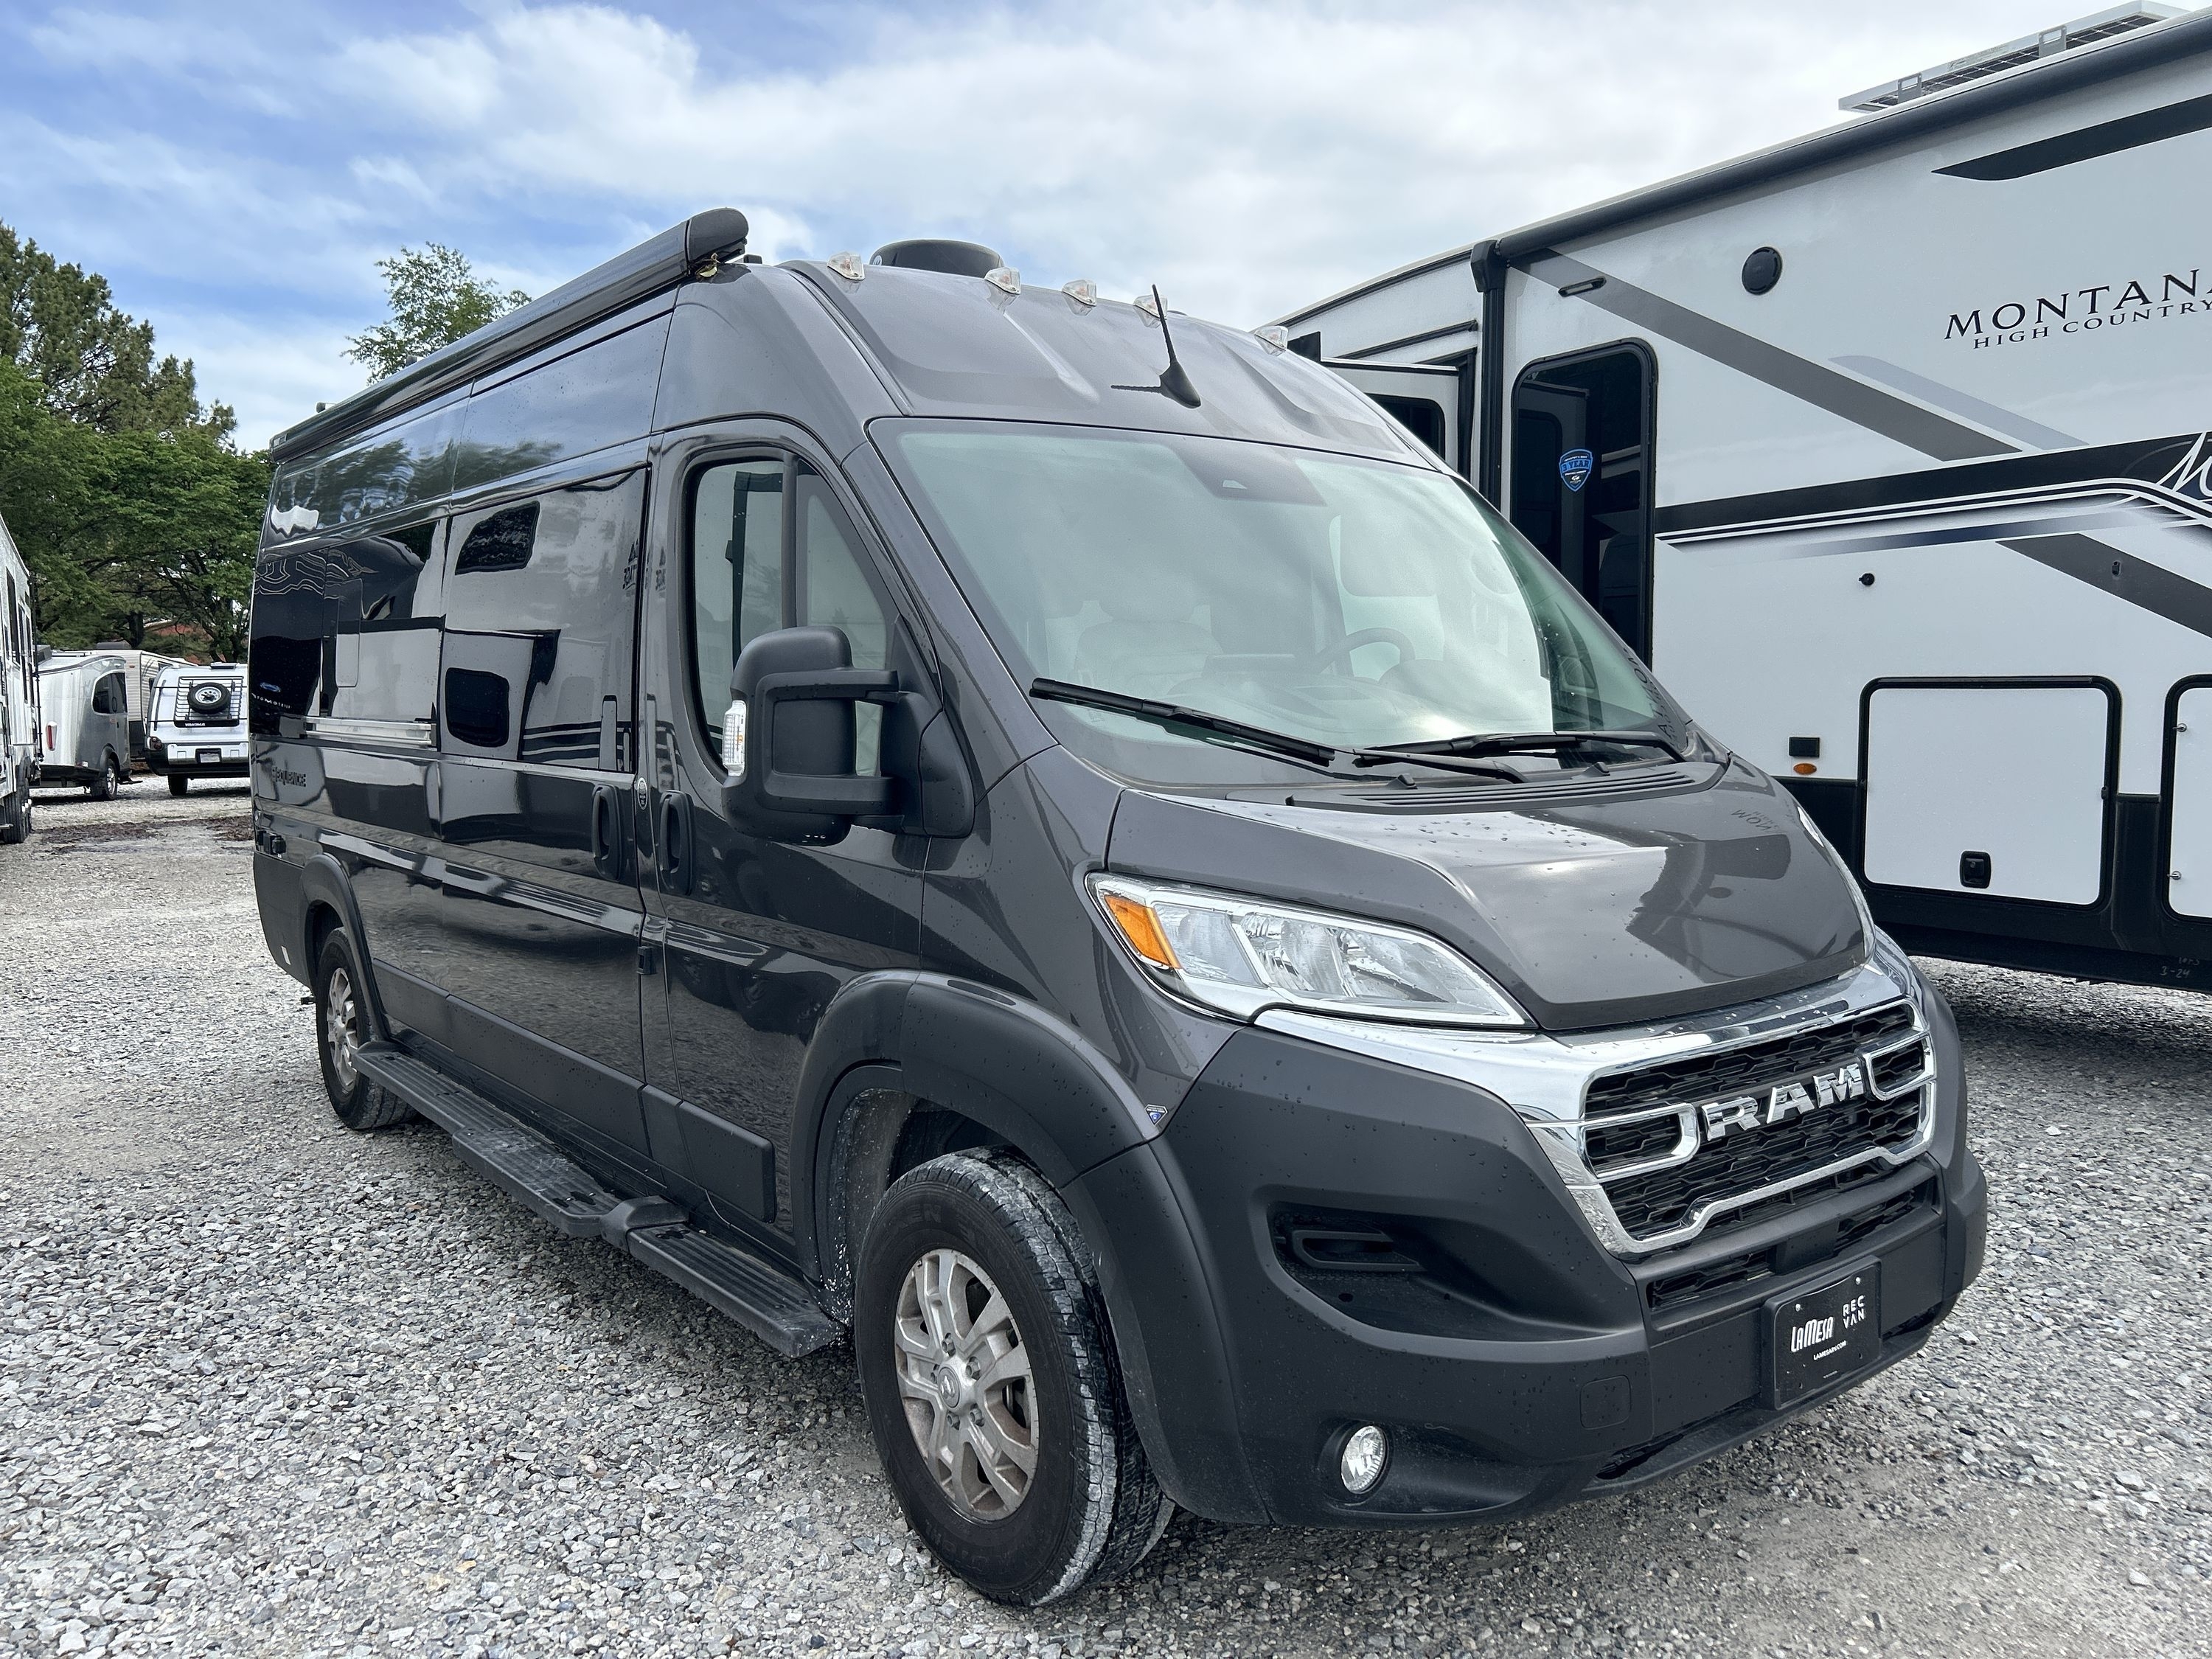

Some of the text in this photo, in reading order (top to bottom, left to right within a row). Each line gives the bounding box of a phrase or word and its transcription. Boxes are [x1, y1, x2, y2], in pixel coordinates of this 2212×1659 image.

[1944, 268, 2212, 340] MONTAN
[1973, 299, 2212, 349] HIGH COUNTRY
[1568, 459, 1590, 469] YEAR
[1701, 1062, 1865, 1141] RAM
[1843, 1295, 1865, 1317] REC
[1843, 1309, 1865, 1329] VAN
